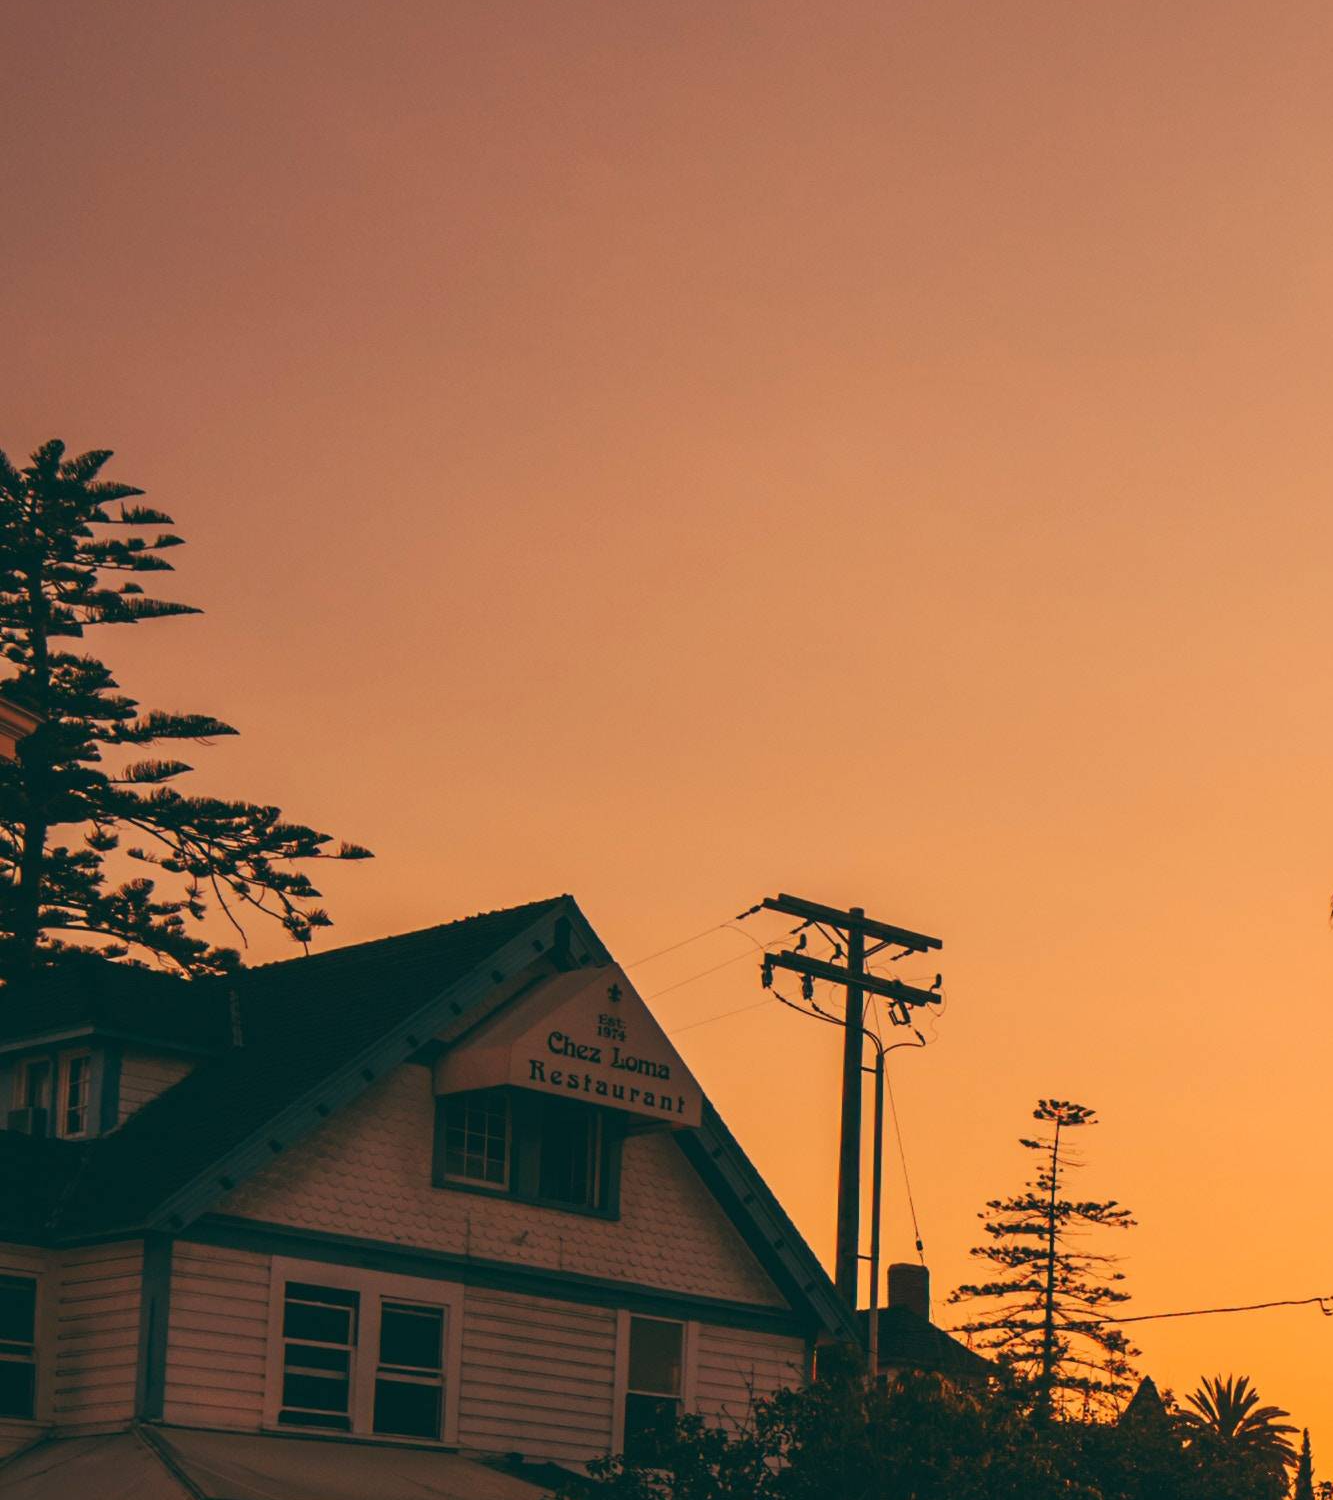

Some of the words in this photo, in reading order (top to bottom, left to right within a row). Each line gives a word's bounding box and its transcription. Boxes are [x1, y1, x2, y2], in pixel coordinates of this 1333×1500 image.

[597, 1025, 626, 1042] 1974
[598, 1013, 626, 1029] Est.
[547, 1031, 602, 1063] Chez
[611, 1047, 670, 1080] Loma
[529, 1059, 685, 1113] Restaurant
